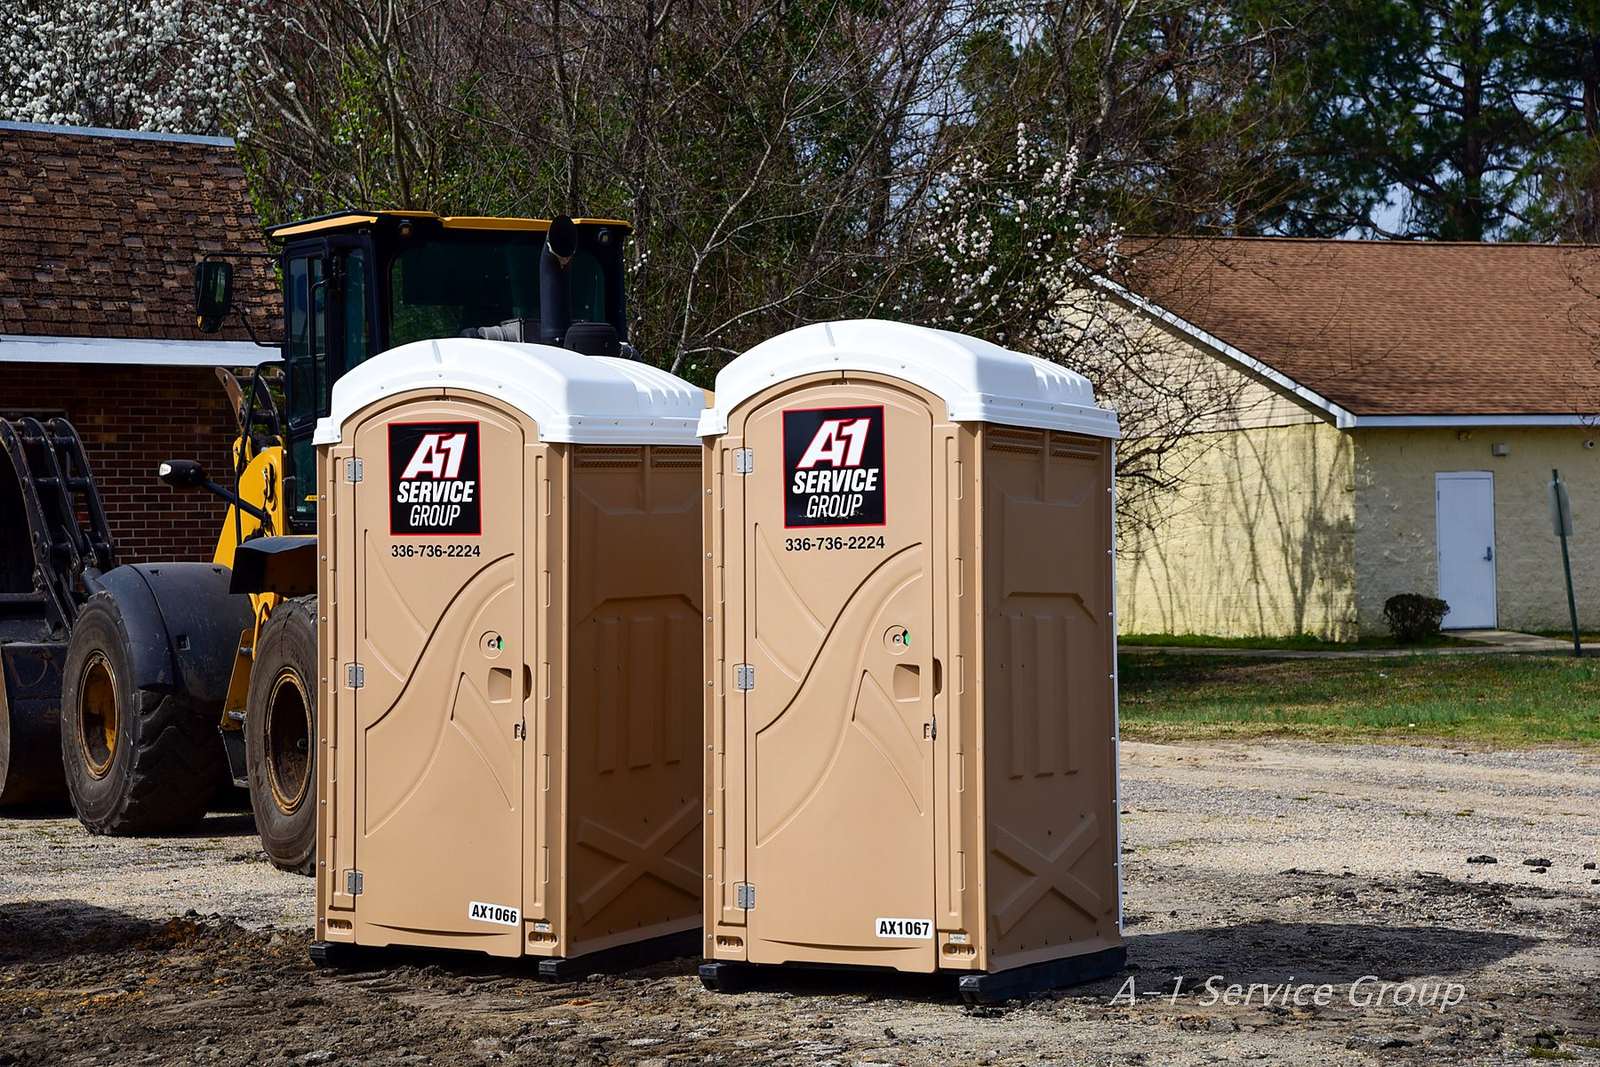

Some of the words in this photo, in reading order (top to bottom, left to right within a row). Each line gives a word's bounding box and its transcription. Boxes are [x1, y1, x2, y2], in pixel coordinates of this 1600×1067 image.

[796, 418, 871, 469] A1
[400, 432, 467, 479] A1
[397, 480, 475, 503] SERVICE
[792, 468, 879, 494] SERVICE
[409, 504, 461, 527] GROUP
[806, 494, 863, 518] GROUP
[391, 545, 481, 557] 336-736-2224
[785, 536, 885, 551] 336-736-2224
[471, 904, 517, 923] AX1066
[879, 921, 930, 936] AX1067
